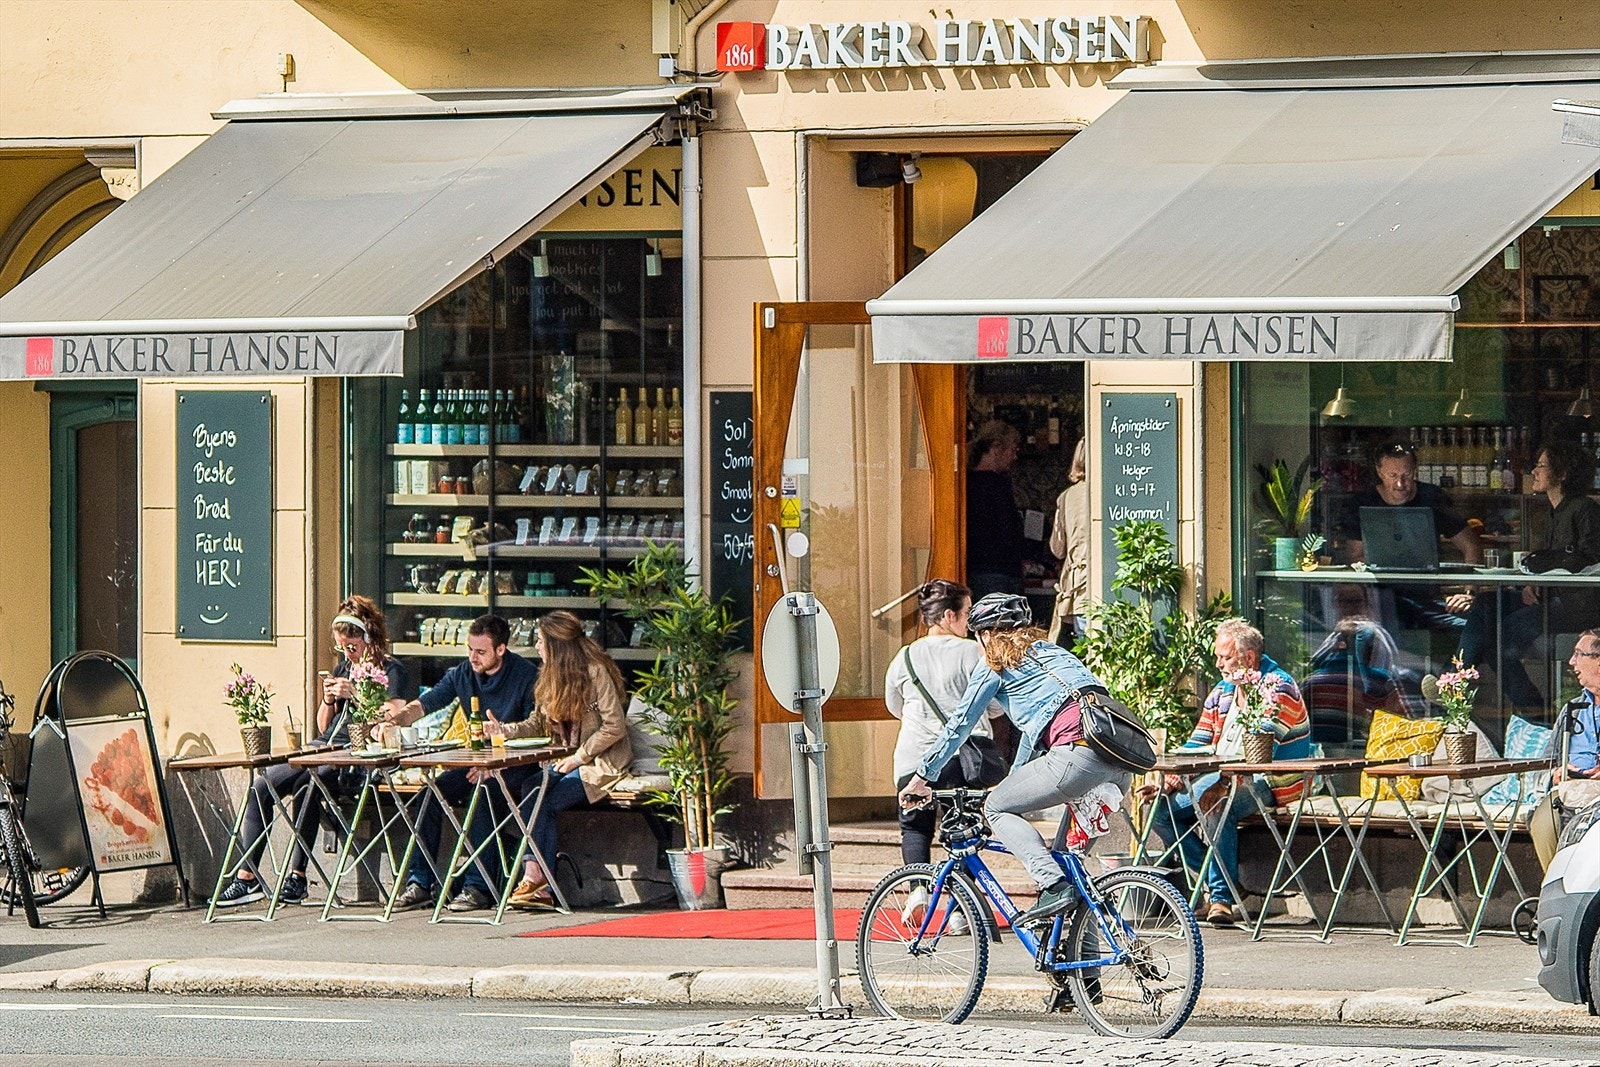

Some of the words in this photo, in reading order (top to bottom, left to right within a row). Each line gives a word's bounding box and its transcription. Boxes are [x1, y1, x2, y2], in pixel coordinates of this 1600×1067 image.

[724, 43, 756, 67] 1861
[764, 20, 922, 70] BAKER
[932, 15, 1141, 67] HANSEN
[578, 168, 683, 208] SEN
[1014, 316, 1150, 355] BAKER
[1161, 316, 1341, 355] HANSEN
[59, 336, 176, 374] BAKER
[187, 334, 340, 372] HANSEN
[192, 423, 238, 458] Byens
[1110, 415, 1170, 440] Åpningstider
[192, 460, 236, 486] Beste
[1122, 464, 1154, 481] Helger
[193, 493, 232, 520] Brød
[195, 559, 242, 588] HER!
[132, 851, 162, 861] HANSEN
